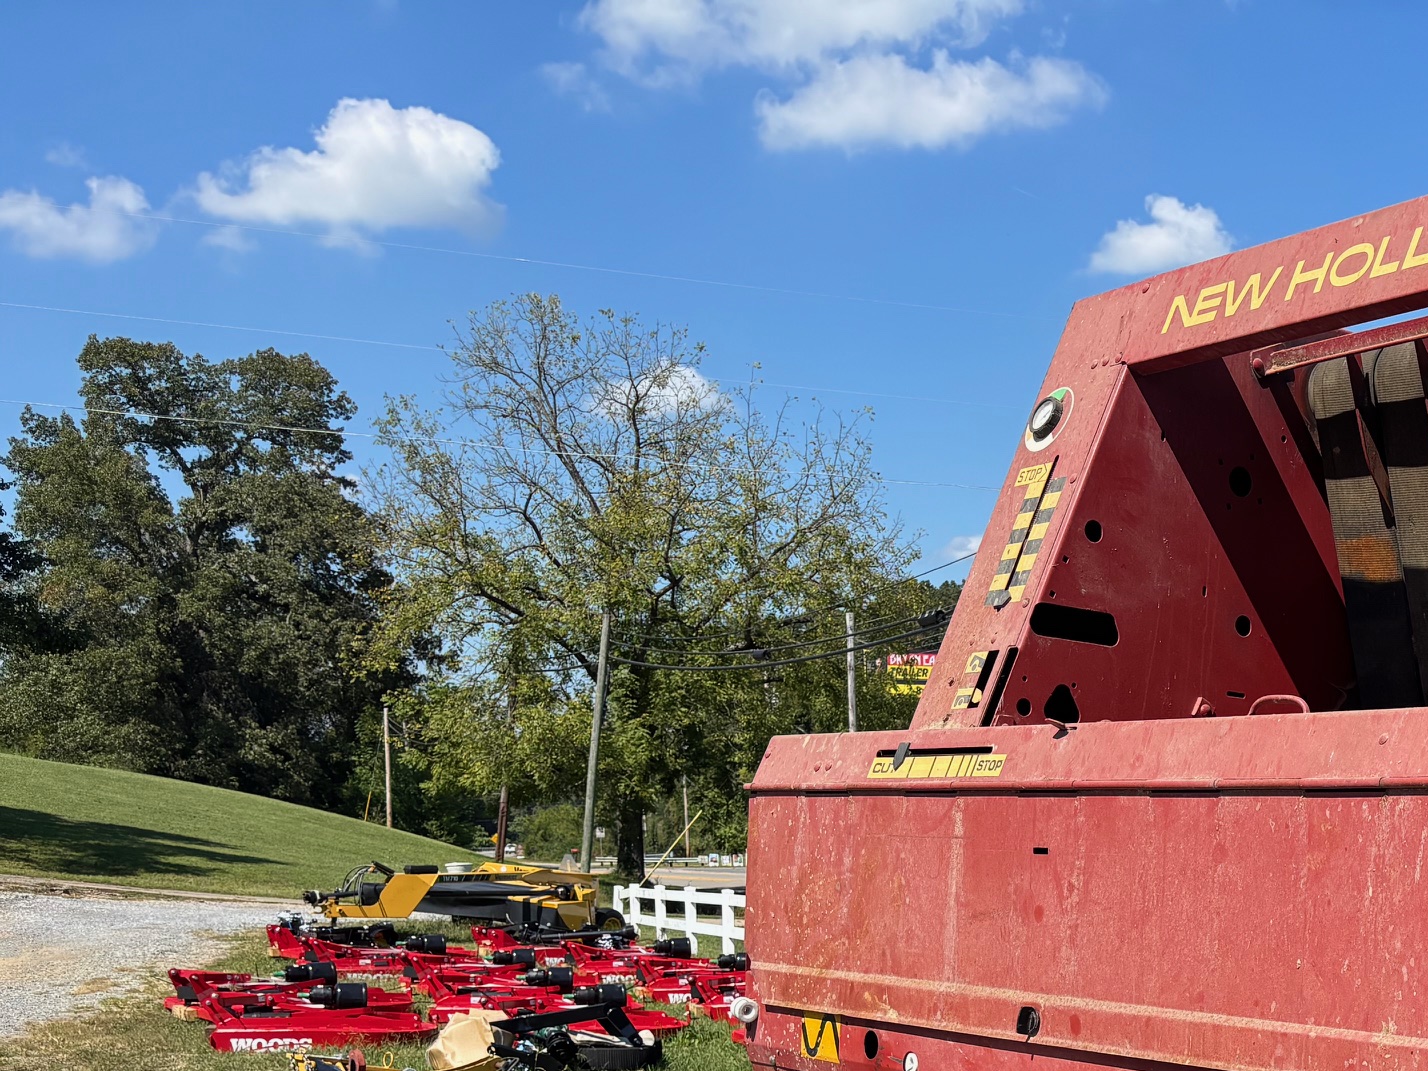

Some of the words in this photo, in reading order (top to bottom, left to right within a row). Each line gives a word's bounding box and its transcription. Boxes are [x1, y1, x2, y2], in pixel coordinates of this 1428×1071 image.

[1160, 266, 1284, 335] NEW
[1017, 466, 1042, 484] STOP
[976, 759, 1004, 771] STOP
